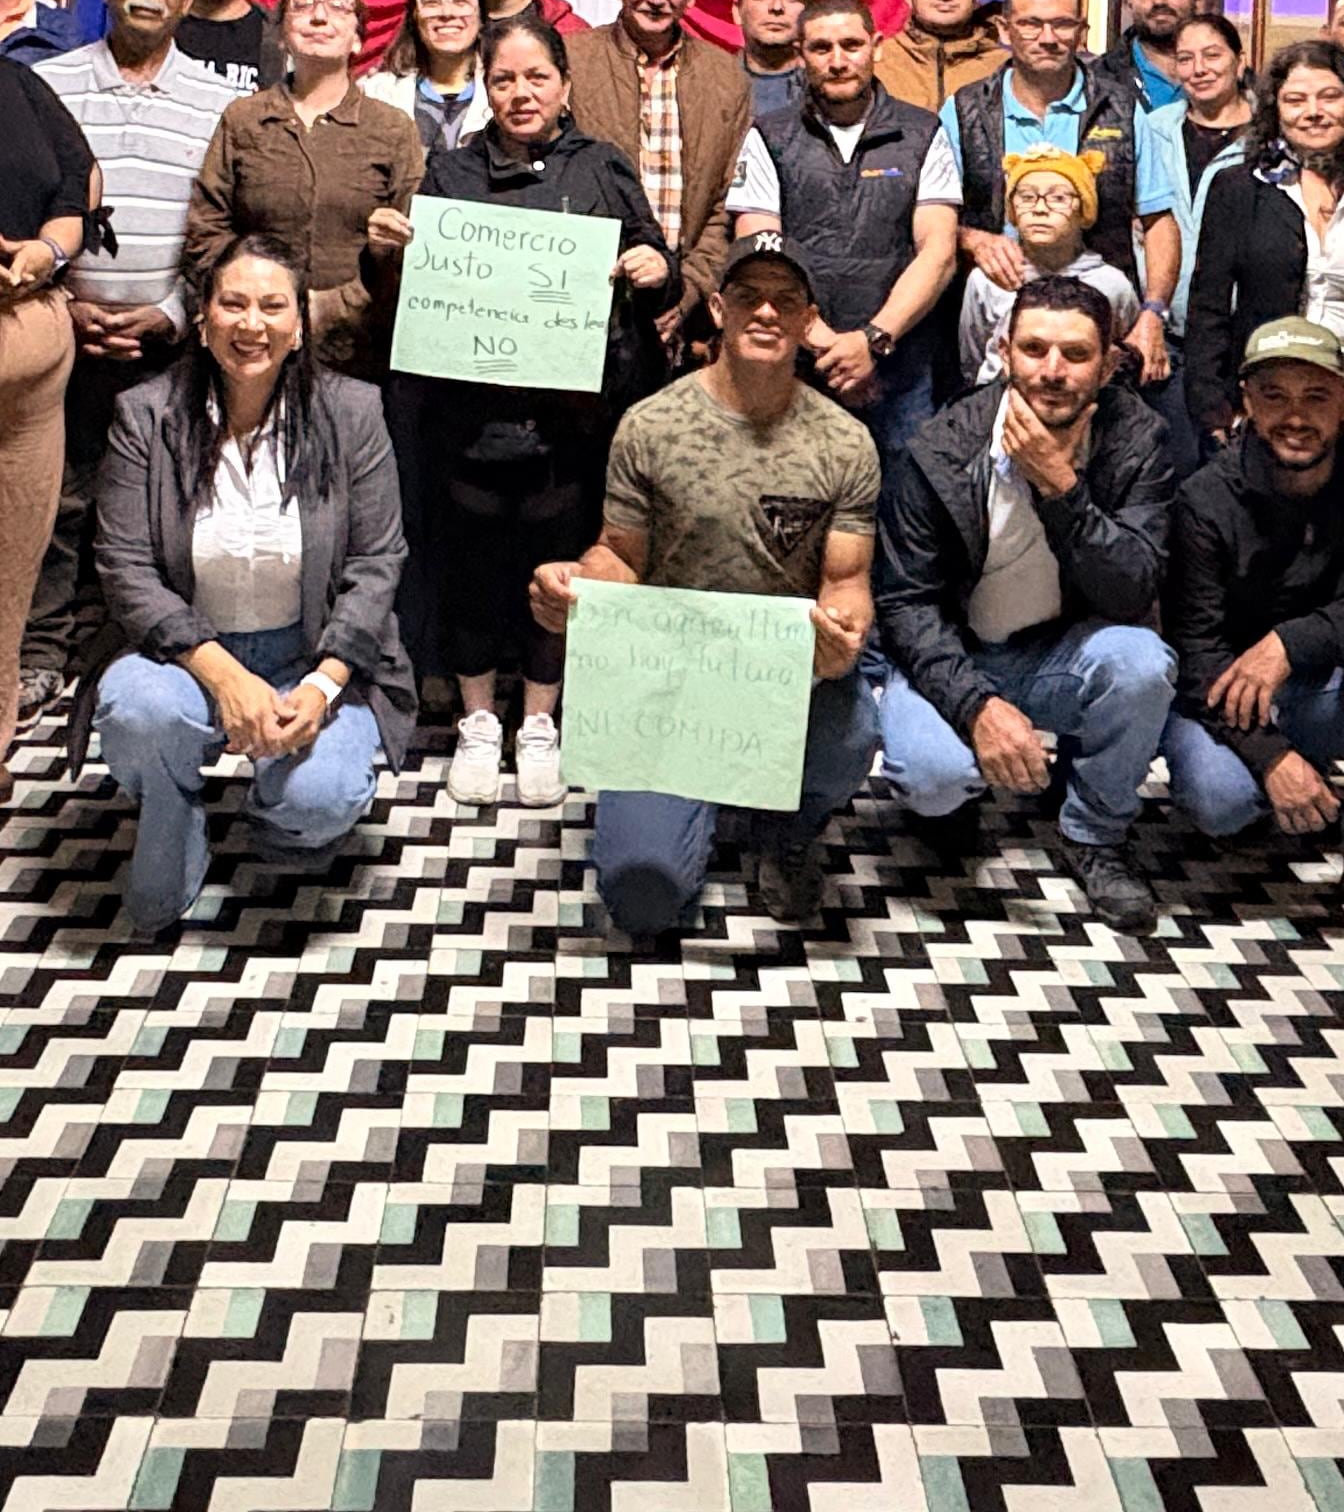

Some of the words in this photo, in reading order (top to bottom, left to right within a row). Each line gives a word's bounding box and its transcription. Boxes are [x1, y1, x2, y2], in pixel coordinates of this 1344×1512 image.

[438, 207, 577, 256] Comercio
[755, 232, 783, 252] NY
[414, 242, 493, 280] Justo
[408, 294, 529, 323] competencia
[473, 336, 518, 357] NO
[634, 708, 763, 758] COMIDA
